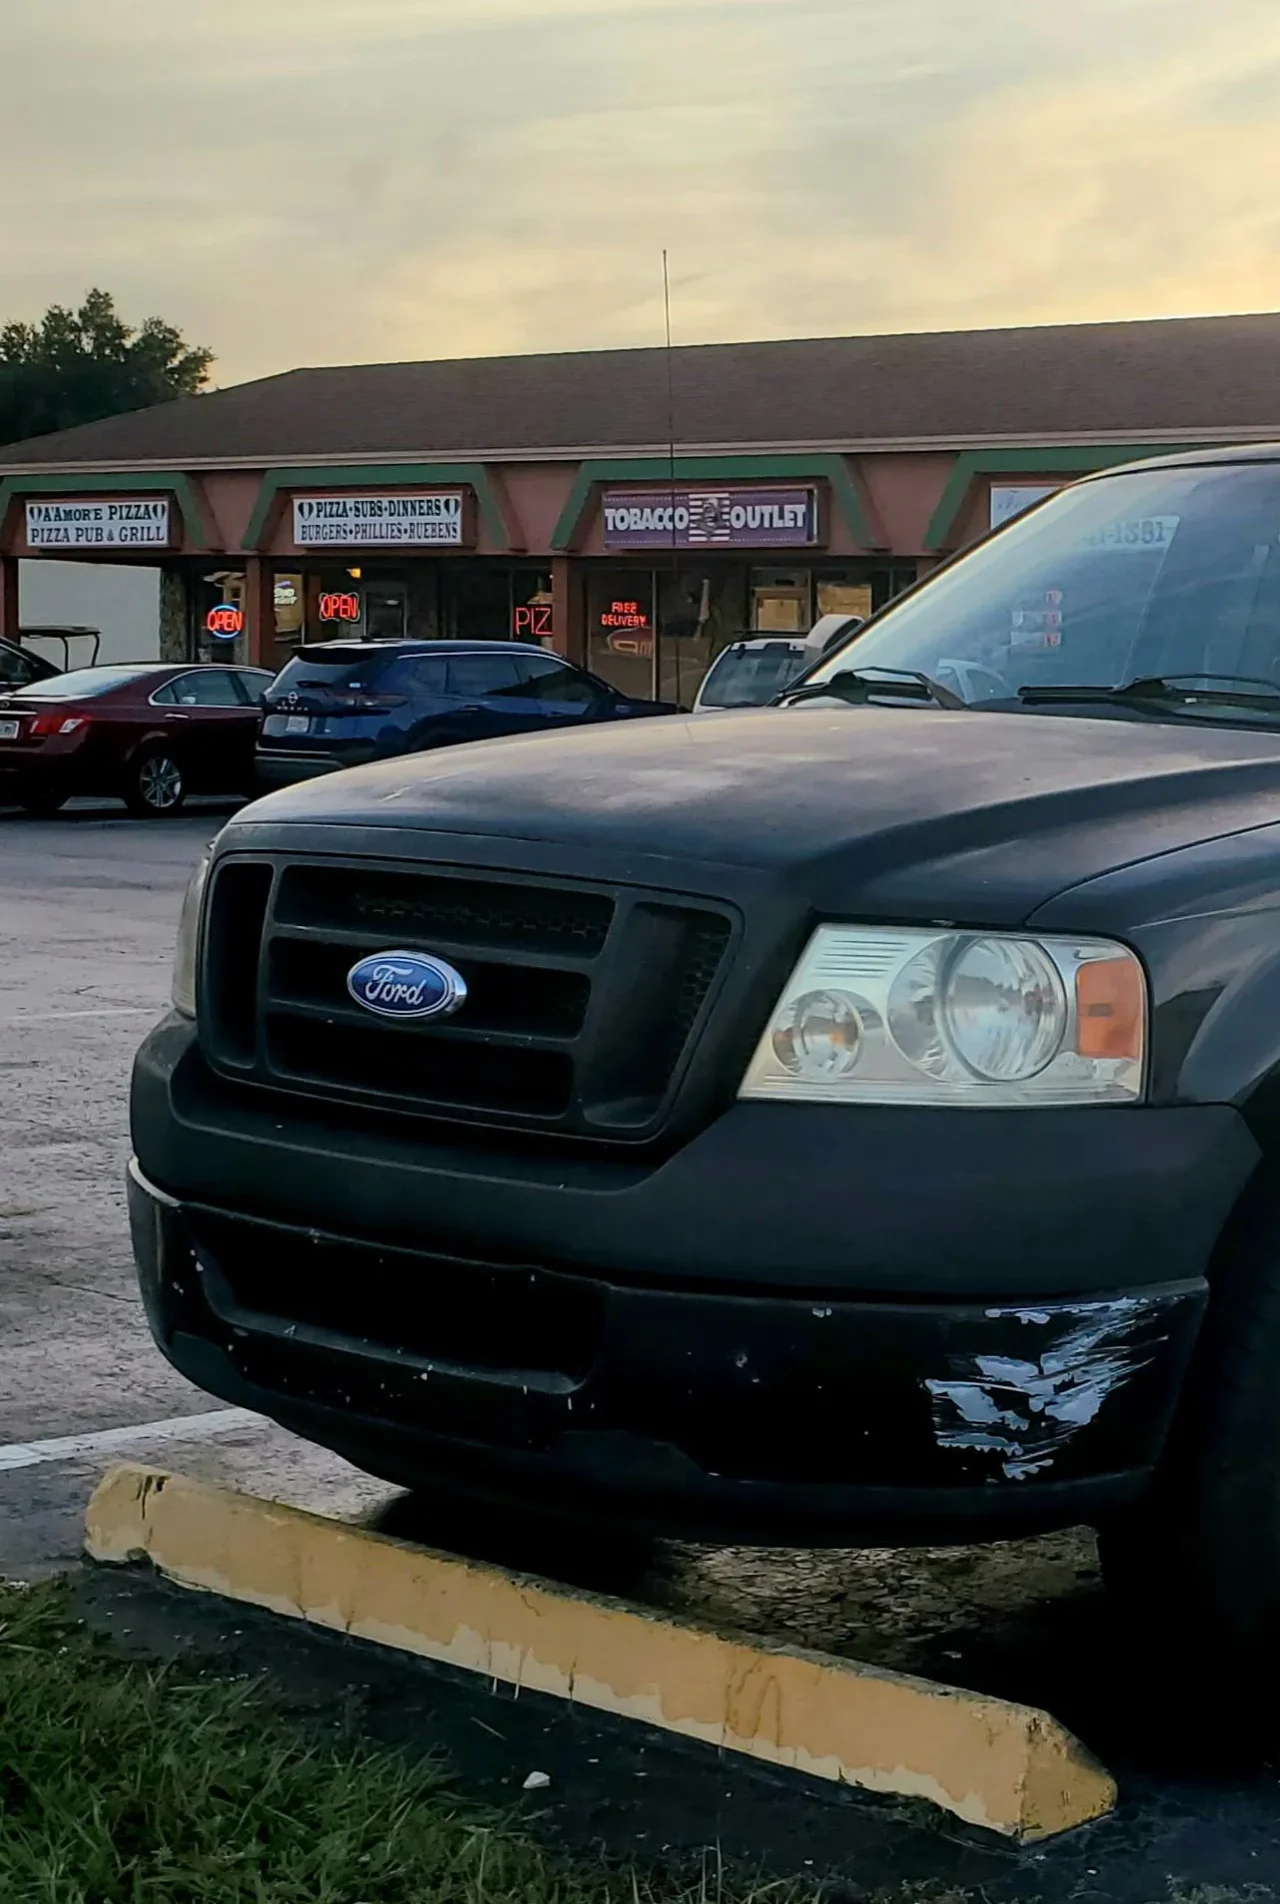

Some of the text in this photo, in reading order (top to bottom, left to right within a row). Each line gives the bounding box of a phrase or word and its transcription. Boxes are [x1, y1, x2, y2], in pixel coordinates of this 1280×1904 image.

[108, 504, 152, 520] PIZZA
[604, 504, 806, 531] TOBACCO OUTLET
[31, 527, 71, 543] PIZZA
[75, 527, 104, 542] PUB
[119, 526, 165, 542] GRILL
[321, 594, 358, 618] OPEN
[207, 611, 244, 632] OPEN
[601, 615, 647, 627] DELIVERY
[365, 964, 428, 1006] Ford
